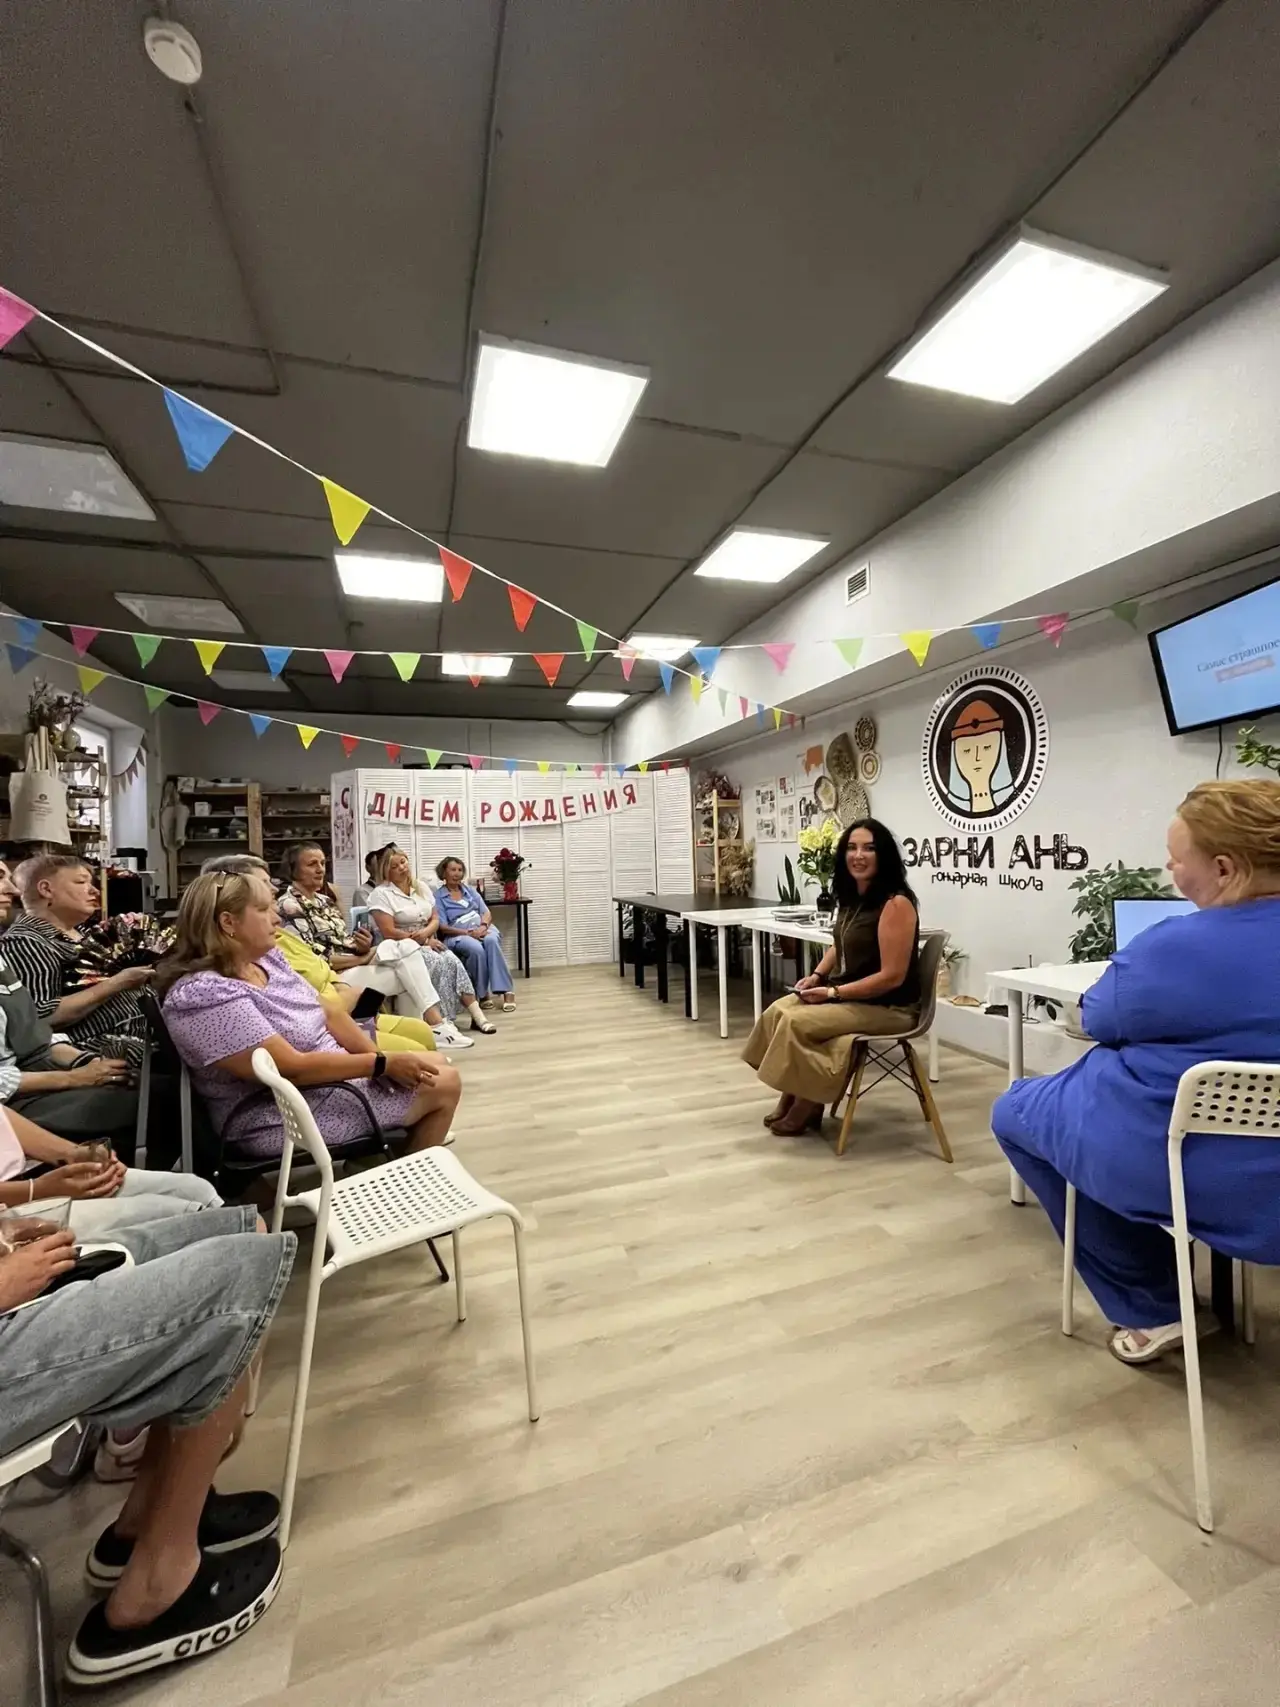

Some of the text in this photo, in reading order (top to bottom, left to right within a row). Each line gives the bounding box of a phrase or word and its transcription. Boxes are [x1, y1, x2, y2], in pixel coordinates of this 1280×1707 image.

[367, 792, 460, 823] ДНЕМ
[481, 783, 637, 824] РОЖДЕНИЯ
[902, 833, 1089, 870] ЗАРНИ АНЬ
[931, 871, 988, 889] гончарная
[174, 1597, 267, 1659] crocs
